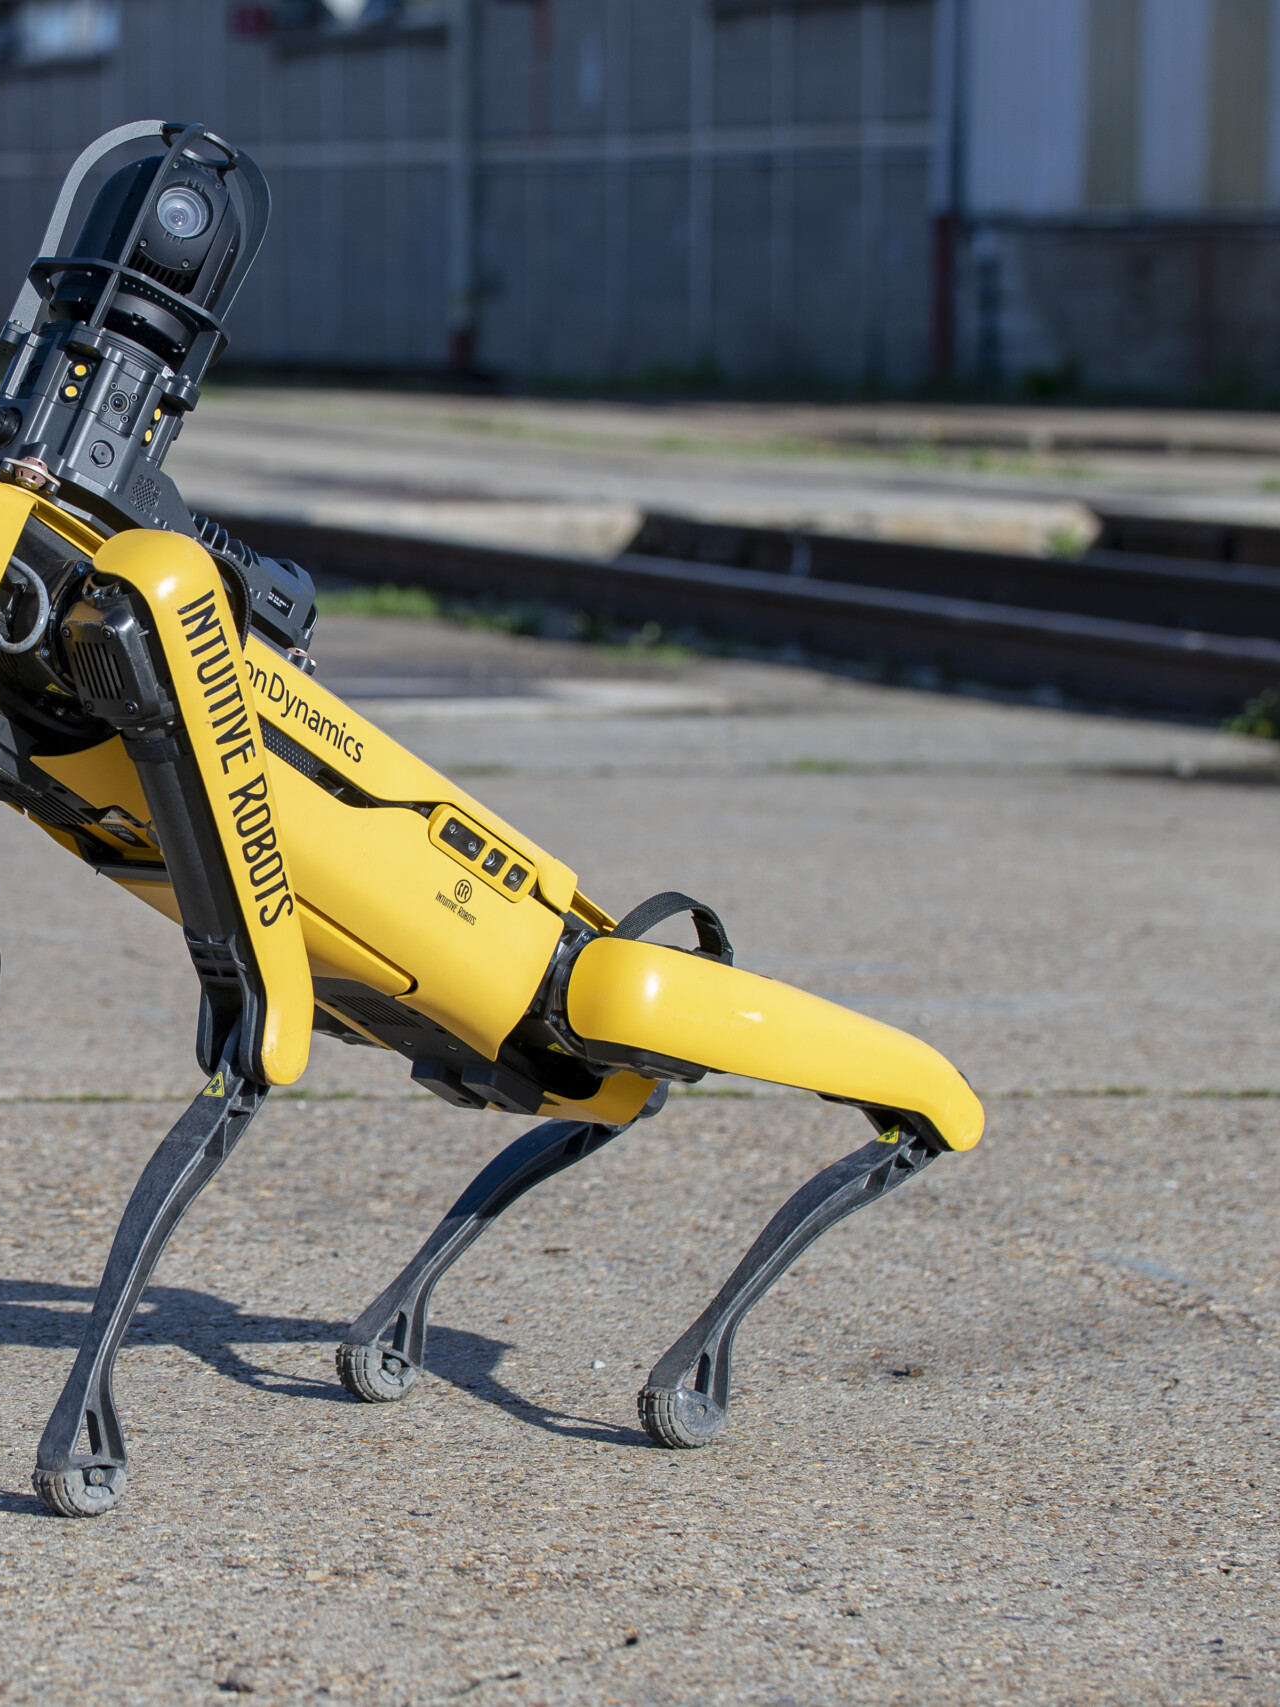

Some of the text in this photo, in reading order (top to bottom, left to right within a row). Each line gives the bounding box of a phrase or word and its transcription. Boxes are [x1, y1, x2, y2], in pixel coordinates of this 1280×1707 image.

[177, 589, 294, 928] INTUITIVE ROBOTS
[435, 891, 476, 925] INTUITIVE ROBOTS
